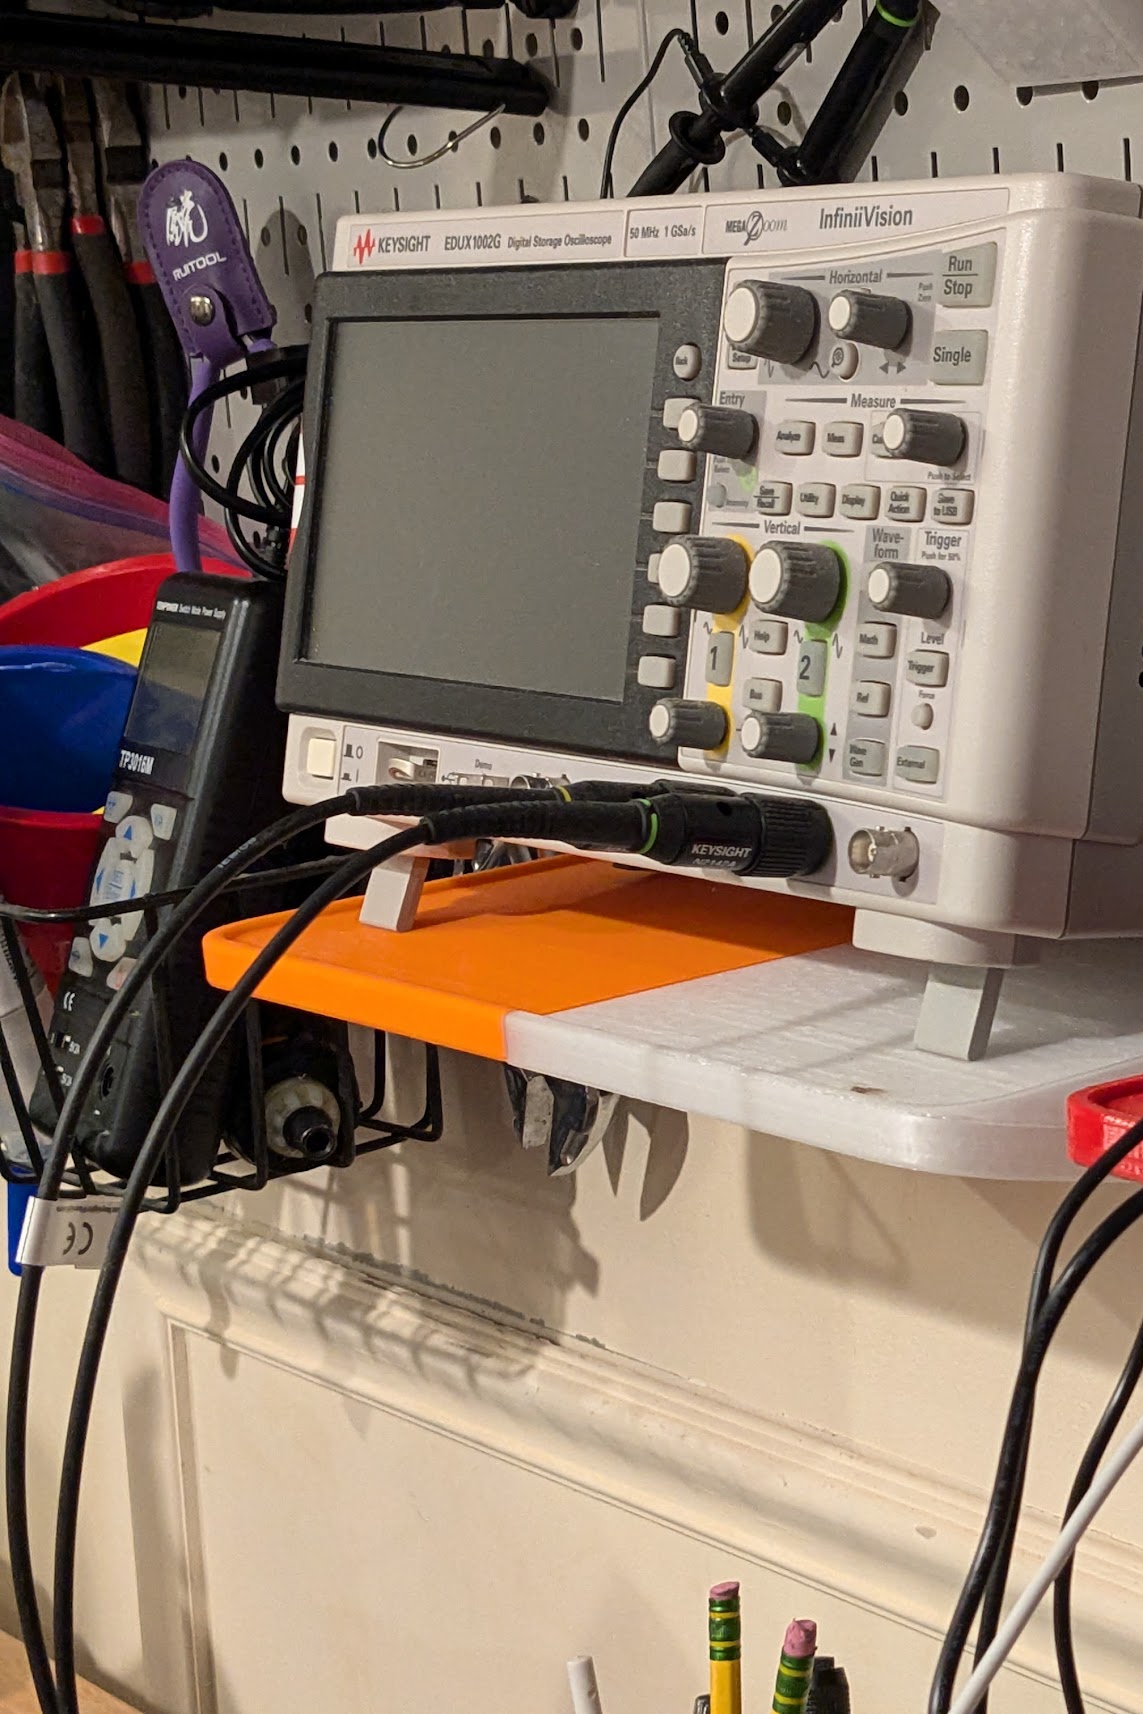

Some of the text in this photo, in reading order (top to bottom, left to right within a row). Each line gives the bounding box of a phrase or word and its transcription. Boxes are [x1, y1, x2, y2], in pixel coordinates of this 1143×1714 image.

[819, 205, 914, 230] InfiniiVision
[629, 224, 696, 239] 50 MHz 1 GSa/s
[378, 235, 431, 254] KEYSIGHT
[444, 233, 612, 251] EDUX1002G Digital Storage Oscilloscope
[948, 255, 973, 272] Run
[829, 269, 882, 285] Horizontal
[943, 278, 973, 299] Stop
[933, 346, 972, 367] Single
[719, 391, 745, 408] Entry
[850, 393, 897, 409] Measure
[842, 494, 866, 507] Display
[890, 491, 909, 502] Quick
[888, 504, 910, 514] Action
[942, 506, 958, 517] USB
[764, 520, 800, 535] Vertical
[872, 528, 904, 544] Wave-
[925, 531, 962, 550] Trigger
[873, 544, 899, 559] form
[753, 629, 771, 643] Help
[859, 632, 879, 645] Math
[920, 631, 945, 646] Level
[709, 646, 719, 671] 1
[799, 655, 811, 680] 2
[907, 660, 935, 675] Trigger
[118, 750, 155, 775] TP3016M
[896, 756, 926, 769] External
[691, 843, 752, 859] KEYSIGHT
